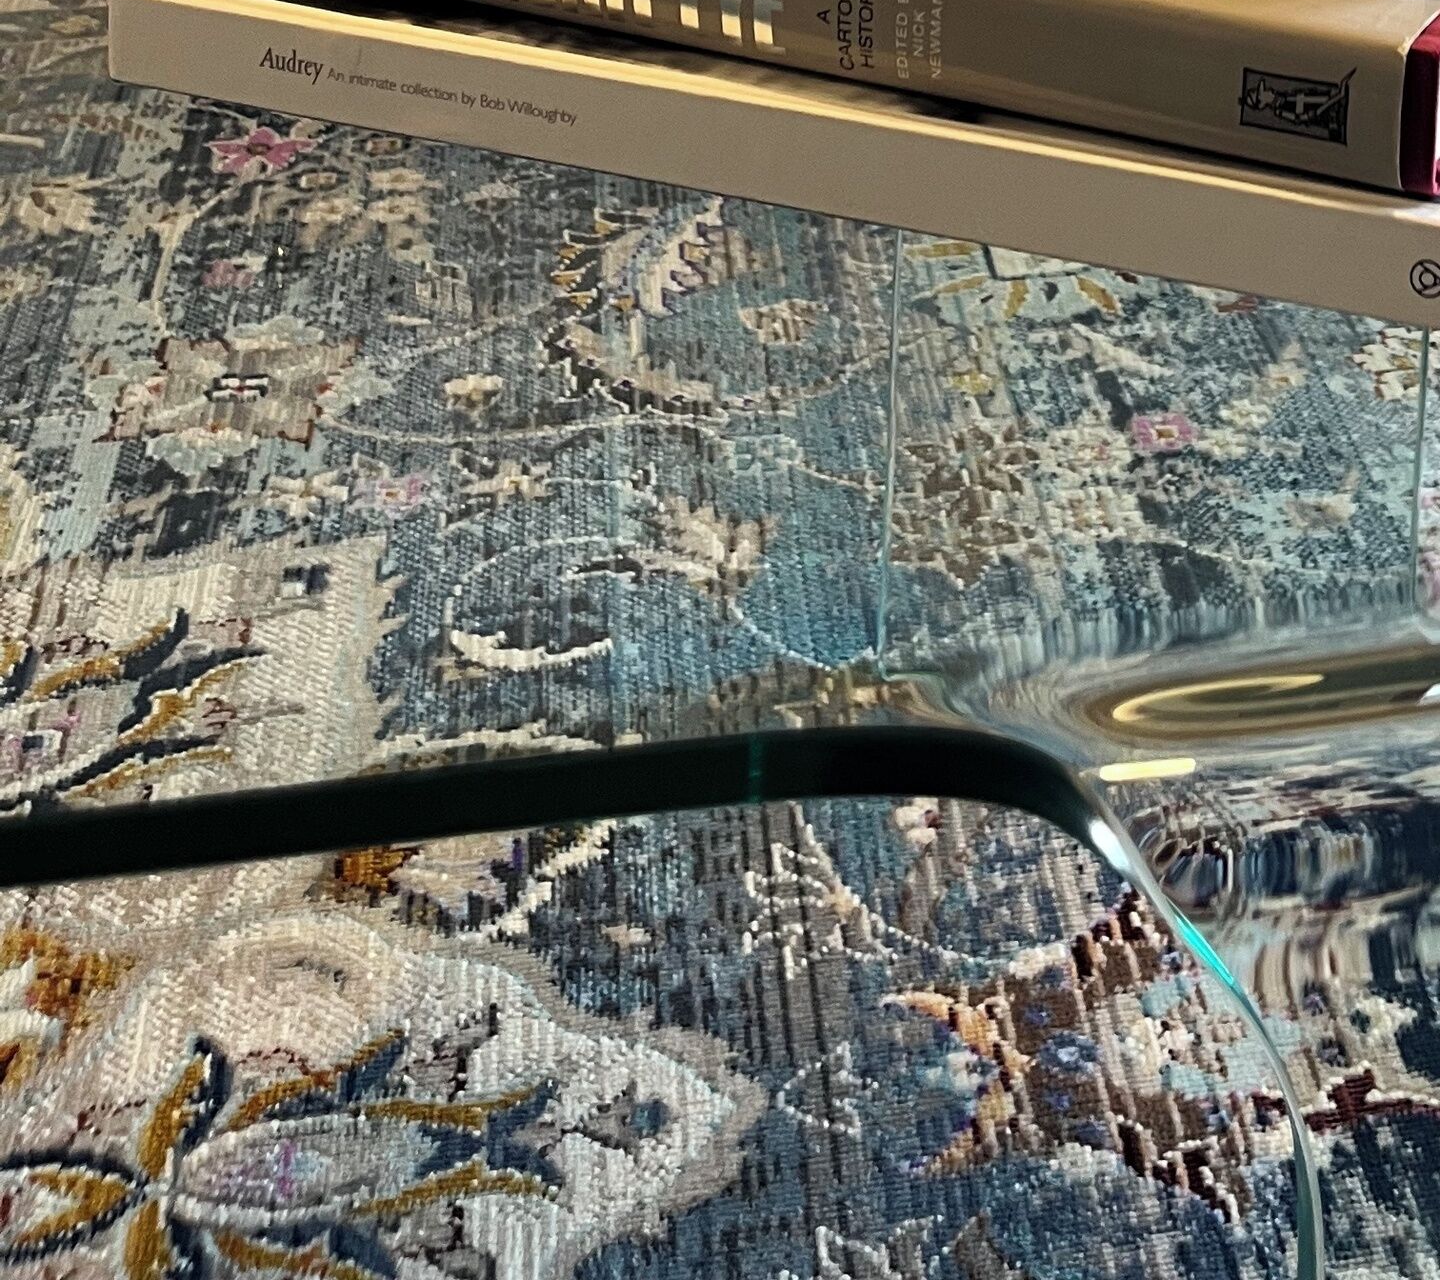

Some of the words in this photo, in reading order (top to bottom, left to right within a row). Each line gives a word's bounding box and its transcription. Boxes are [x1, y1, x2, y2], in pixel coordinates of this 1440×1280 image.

[816, 8, 831, 25] A
[895, 11, 910, 80] EDITED
[912, 8, 926, 58] NICK
[259, 46, 325, 86] Audrey
[326, 66, 346, 82] An
[349, 71, 397, 92] intimate
[400, 79, 458, 103] collection
[461, 90, 477, 109] by
[479, 93, 506, 112] Bob
[507, 99, 578, 128] Willoughby
